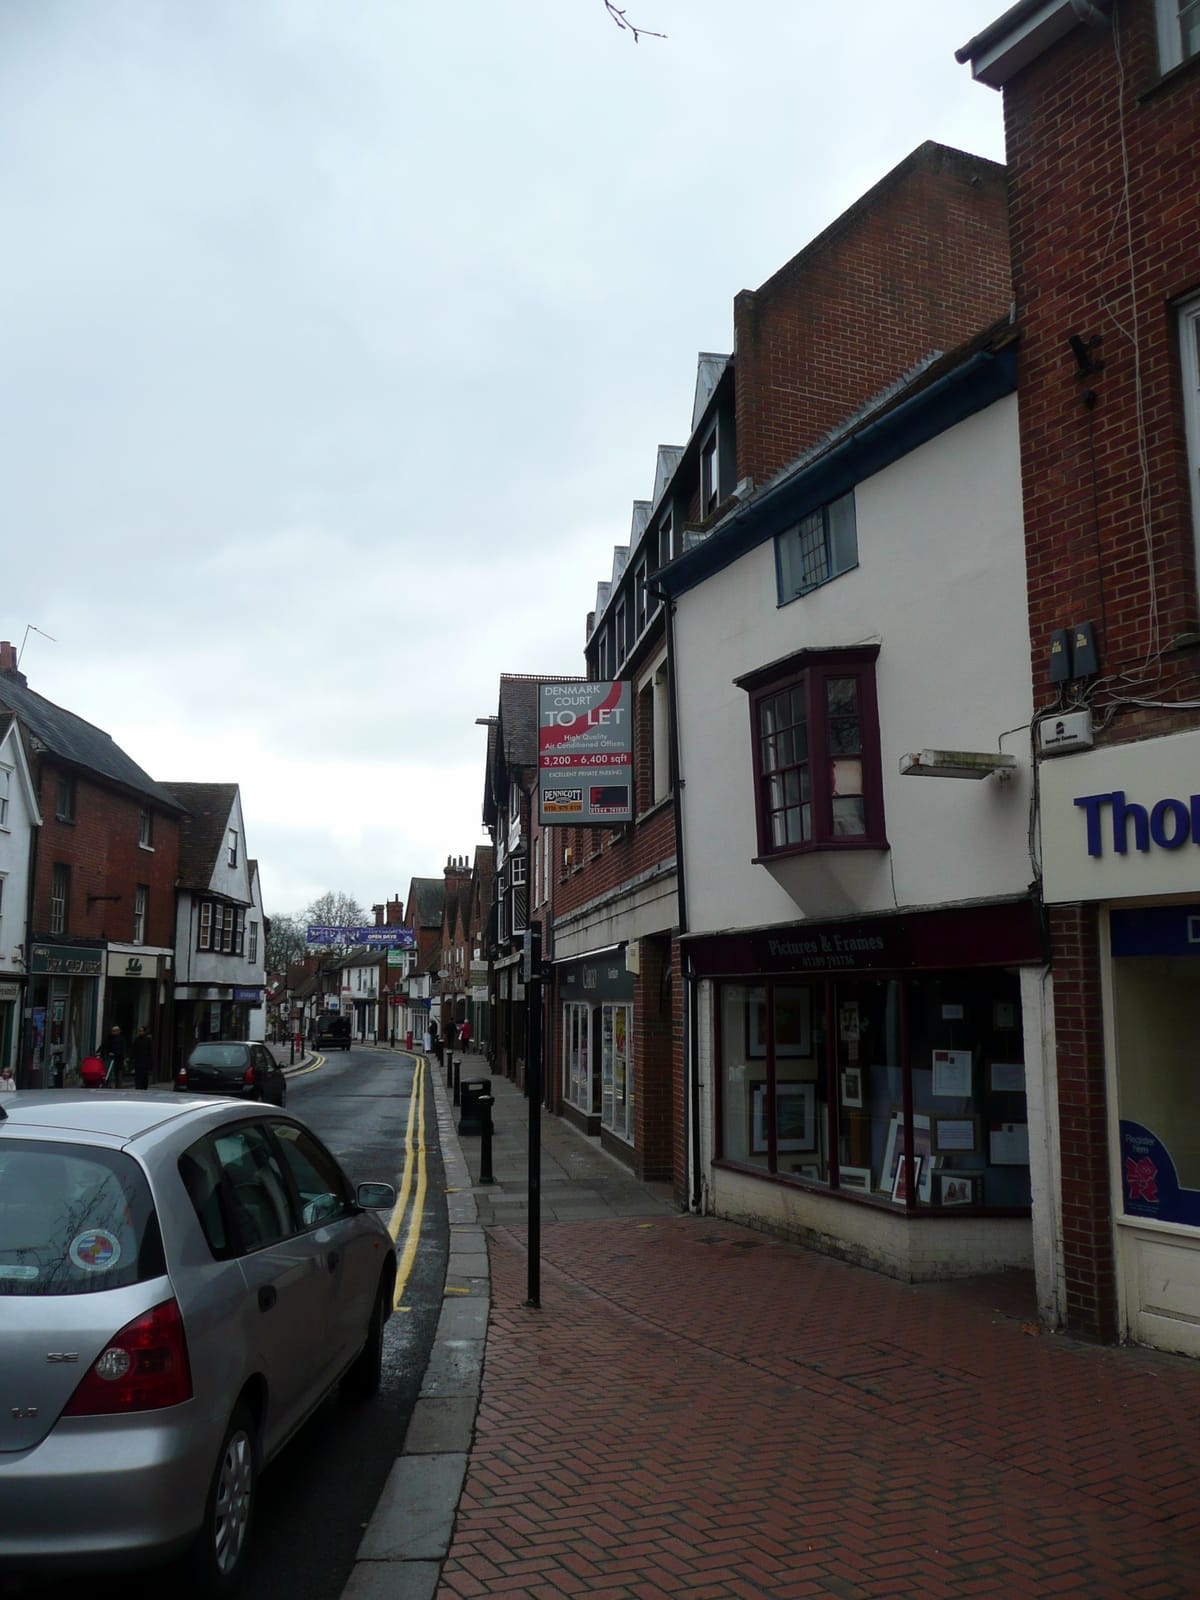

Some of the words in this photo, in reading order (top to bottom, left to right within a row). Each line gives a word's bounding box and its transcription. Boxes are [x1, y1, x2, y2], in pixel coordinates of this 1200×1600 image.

[545, 684, 601, 696] DENMARK
[554, 696, 592, 706] COURT
[545, 710, 577, 727] TO
[587, 708, 625, 726] LET
[564, 734, 581, 742] High
[583, 733, 608, 741] Quality
[556, 741, 599, 749] Conditioned
[600, 740, 625, 748] Offices
[544, 756, 571, 766] 3,200
[580, 754, 608, 765] 6,400
[610, 753, 627, 764] sqft
[545, 789, 581, 801] PENNICOTT
[1073, 790, 1200, 857] Tho
[767, 939, 818, 957] Pictures
[818, 933, 832, 952] &
[832, 933, 884, 952] Frames
[46, 1352, 80, 1363] SE
